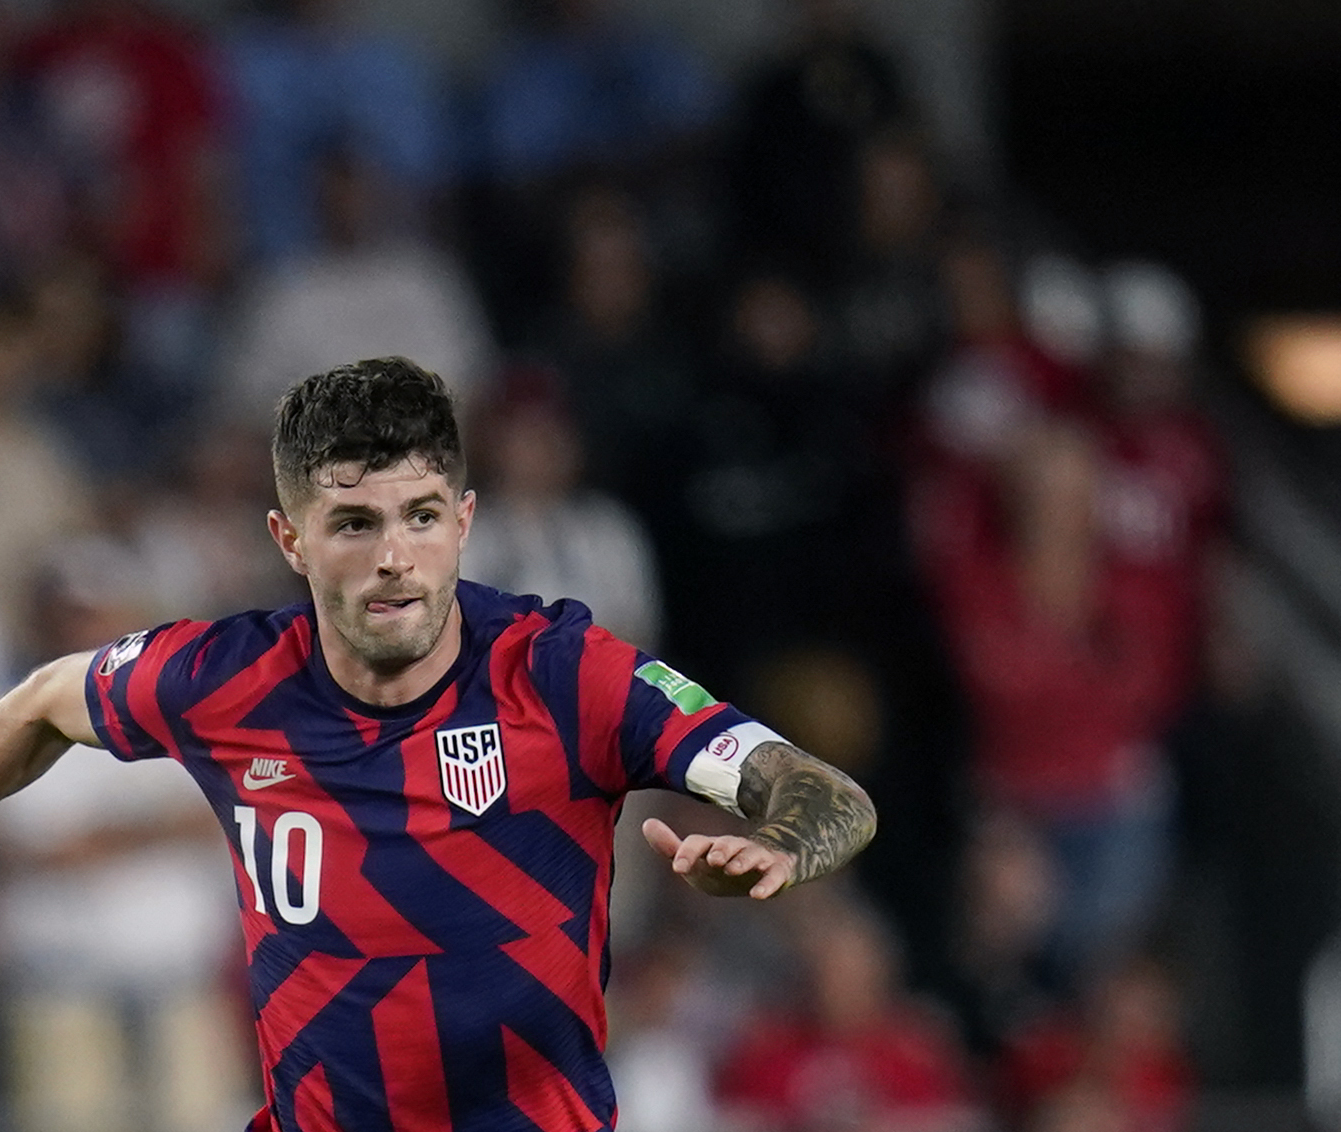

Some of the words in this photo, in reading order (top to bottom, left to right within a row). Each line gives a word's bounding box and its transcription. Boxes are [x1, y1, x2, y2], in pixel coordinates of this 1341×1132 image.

[442, 729, 497, 765] USA
[712, 738, 733, 756] USA
[250, 757, 288, 777] NIKE
[234, 805, 323, 925] 10
